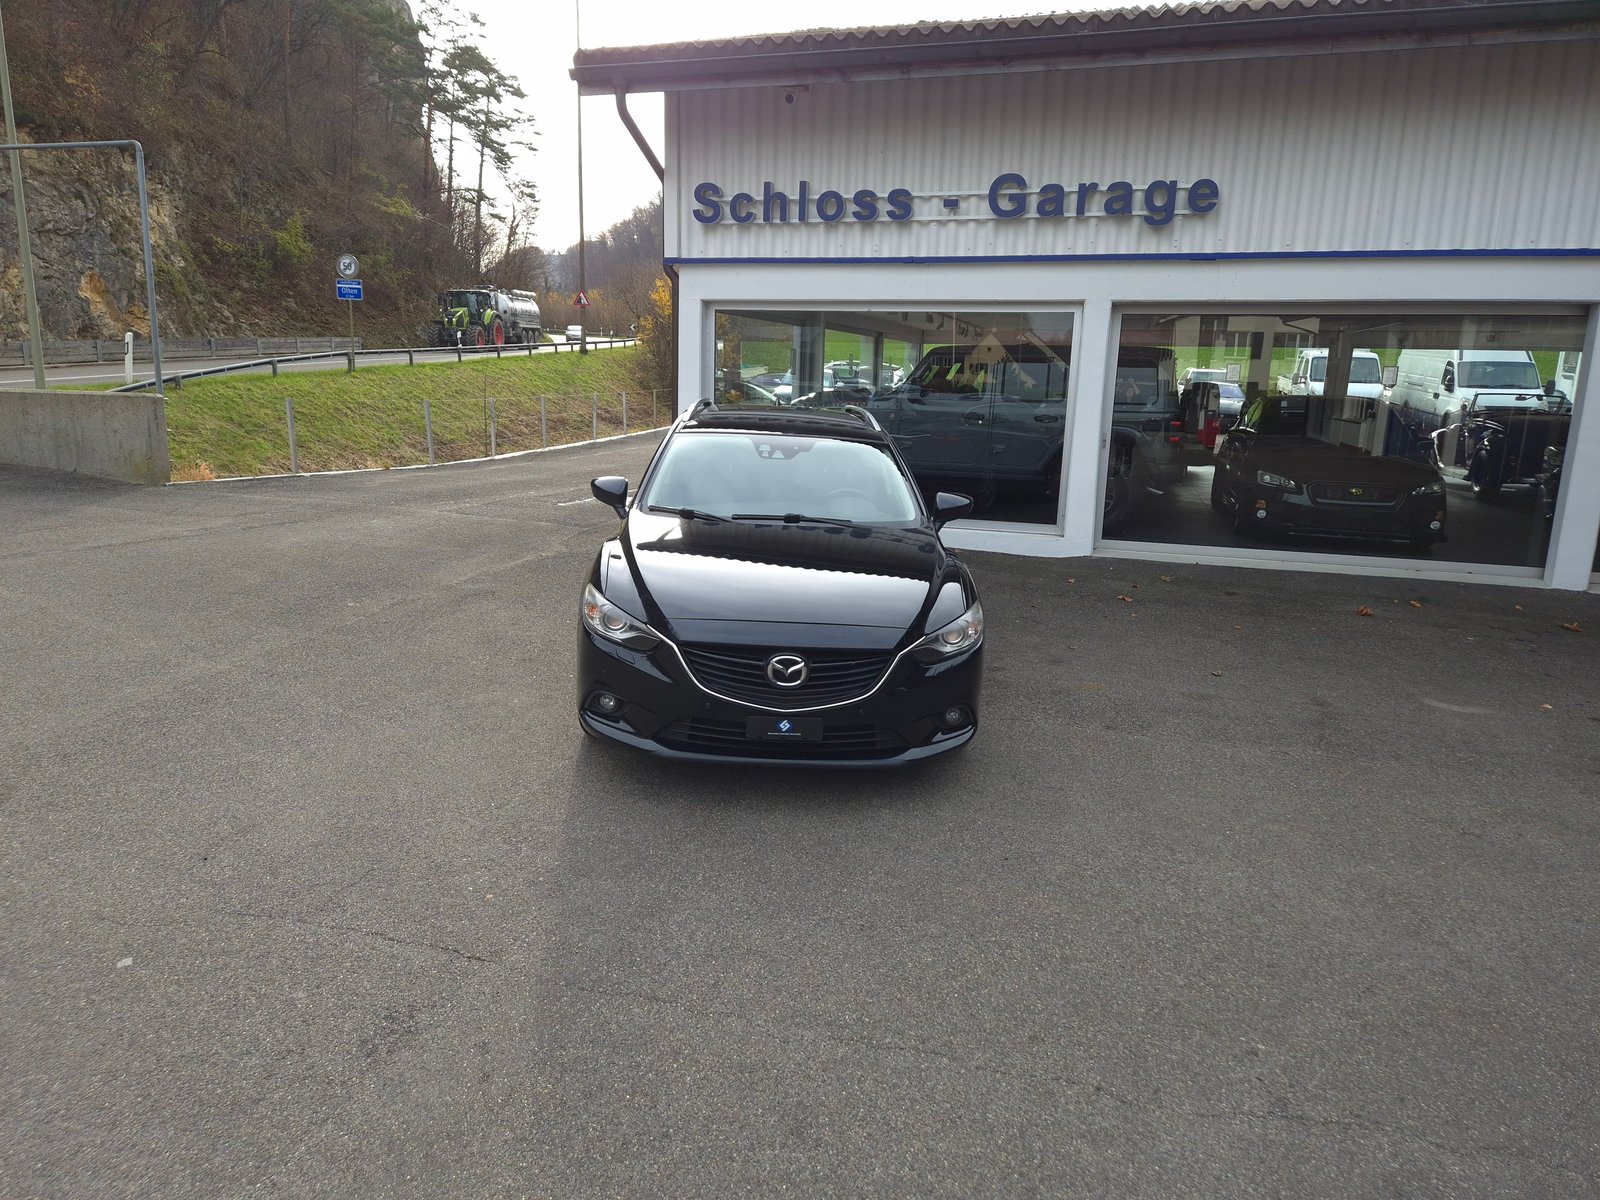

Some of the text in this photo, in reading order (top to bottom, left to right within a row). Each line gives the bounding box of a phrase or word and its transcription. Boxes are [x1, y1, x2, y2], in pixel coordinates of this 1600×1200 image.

[692, 180, 914, 225] Schloss
[988, 172, 1220, 227] Garage
[342, 262, 352, 271] 50
